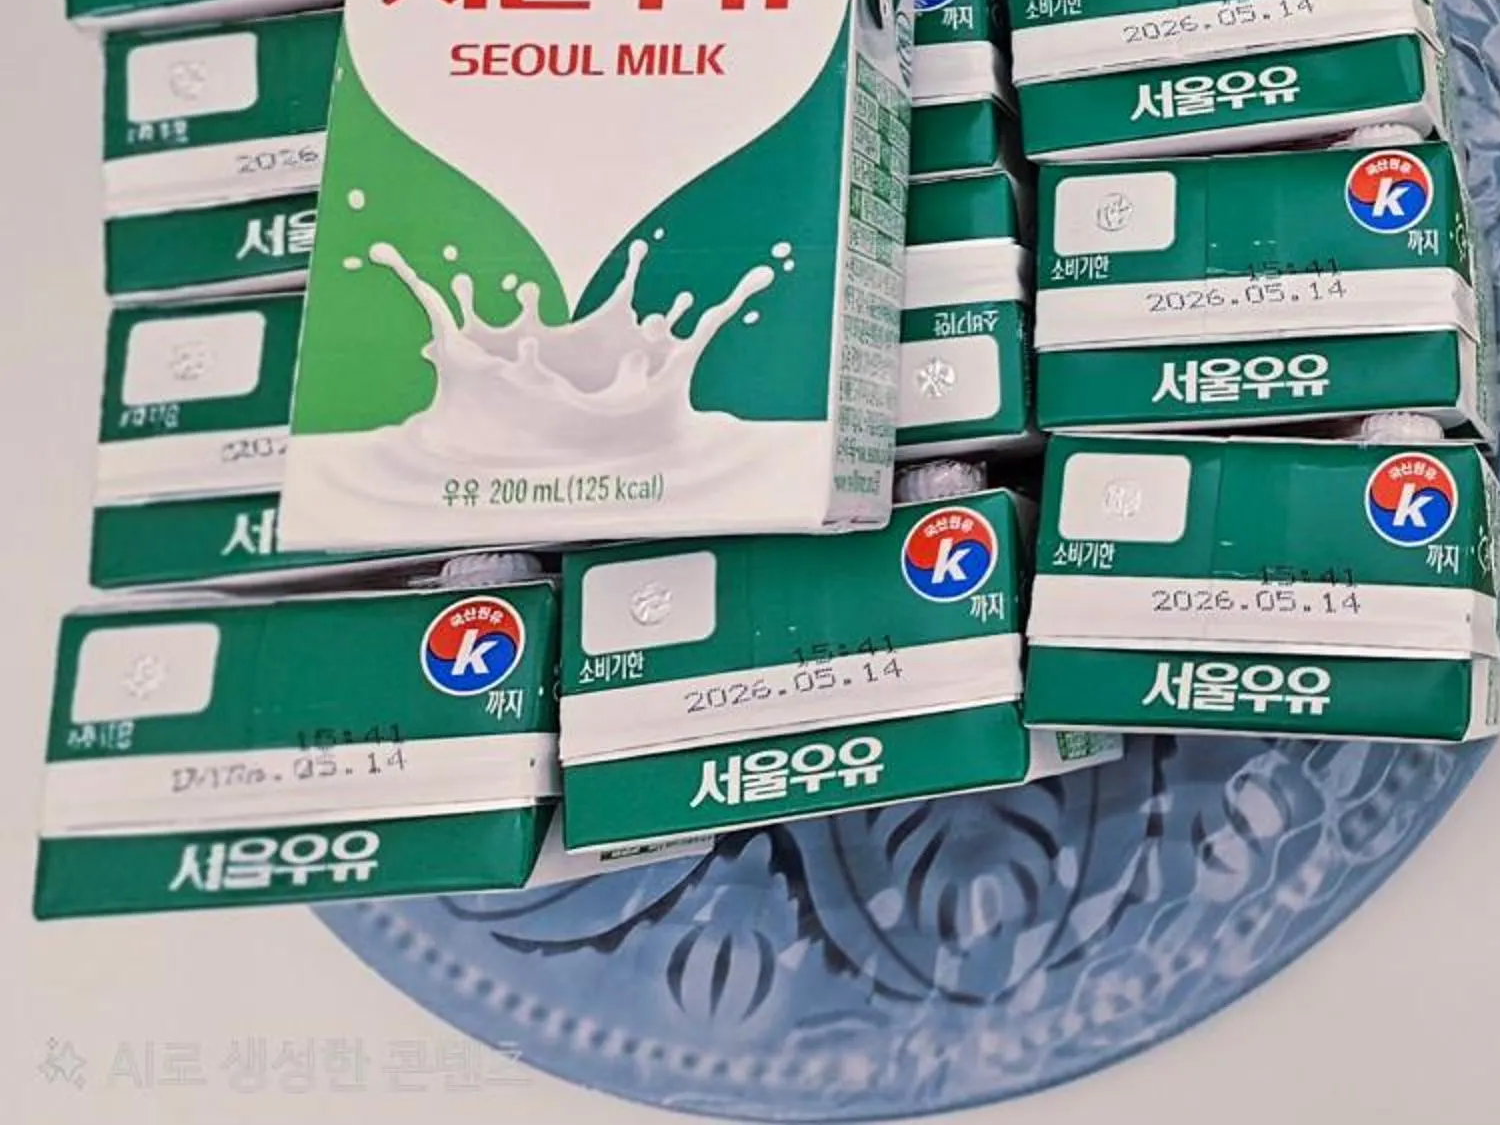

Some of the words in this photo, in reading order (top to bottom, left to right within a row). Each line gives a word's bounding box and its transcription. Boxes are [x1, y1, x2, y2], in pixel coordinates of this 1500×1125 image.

[941, 6, 974, 31] 까지
[449, 43, 605, 77] SEOUL
[616, 43, 727, 77] MILK
[1130, 65, 1300, 122] 서울우유
[1406, 228, 1439, 257] 까지
[1051, 254, 1109, 280] 소비기한
[1146, 279, 1348, 313] 2026.05.14
[1152, 354, 1330, 404] 서울우유
[442, 479, 480, 507] 우유
[489, 478, 527, 504] 200
[614, 473, 665, 501] kcal)
[1052, 540, 1115, 569] 소비기한
[1425, 543, 1460, 574] 까지
[969, 592, 1005, 624] 까지
[1152, 589, 1362, 614] 2026.05.14
[449, 607, 505, 629] 국산원유
[579, 653, 644, 684] 소비기한
[684, 657, 903, 714] 2026.05.14
[1142, 662, 1331, 716] 서울우유
[485, 688, 524, 720] 까지
[690, 736, 884, 809] 서울우유
